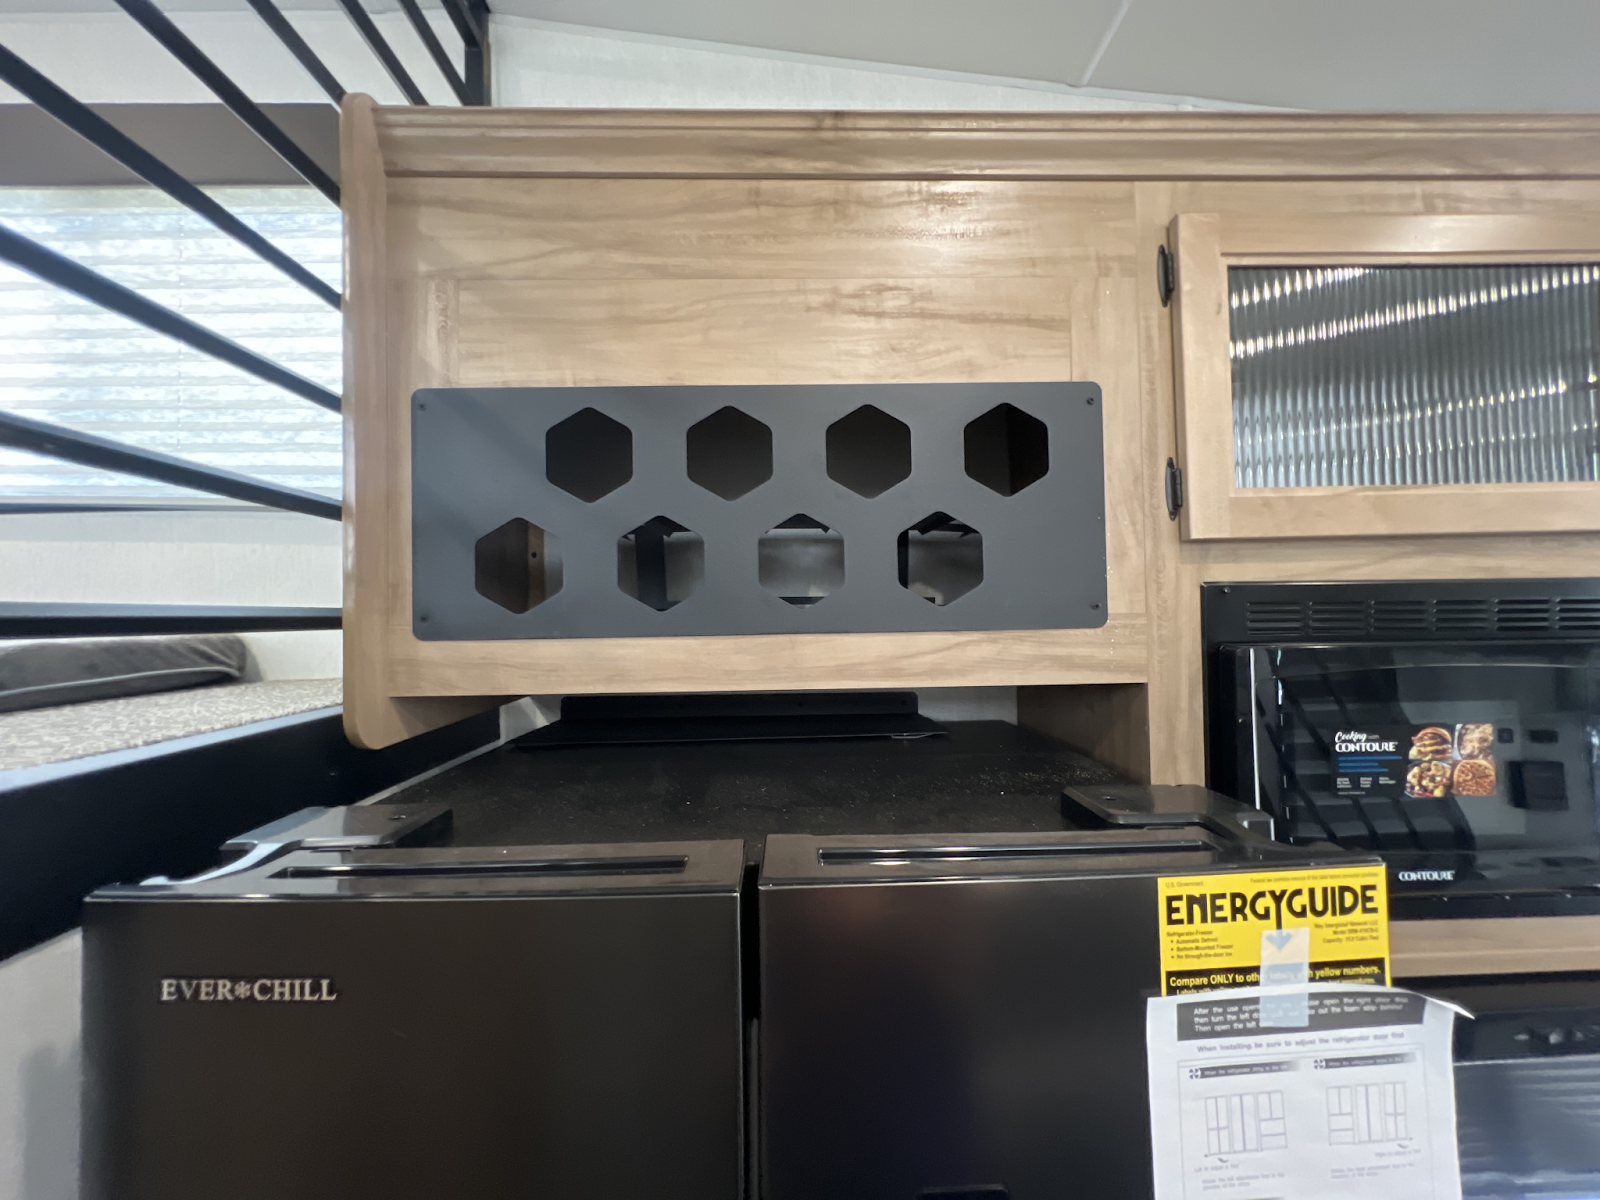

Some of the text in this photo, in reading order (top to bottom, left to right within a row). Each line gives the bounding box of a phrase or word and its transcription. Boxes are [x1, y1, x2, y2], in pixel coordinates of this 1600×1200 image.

[1335, 731, 1367, 743] Cooking
[1335, 742, 1396, 752] CONTOURE
[1398, 870, 1453, 881] CONTOURE
[1166, 884, 1379, 930] ENERGYGUIDE
[1166, 930, 1213, 938] Refrigerator-Freezer
[1169, 976, 1209, 987] Compare
[1210, 974, 1234, 984] ONLY
[1235, 974, 1244, 982] to
[1315, 967, 1342, 980] yellow
[1343, 965, 1381, 975] numbers.
[160, 978, 337, 1001] EVER CHILL
[1240, 1012, 1250, 1020] left
[1214, 1024, 1231, 1032] open
[1197, 1045, 1217, 1053] When
[1295, 1038, 1316, 1046] adjust
[1332, 1035, 1370, 1043] refrigerator
